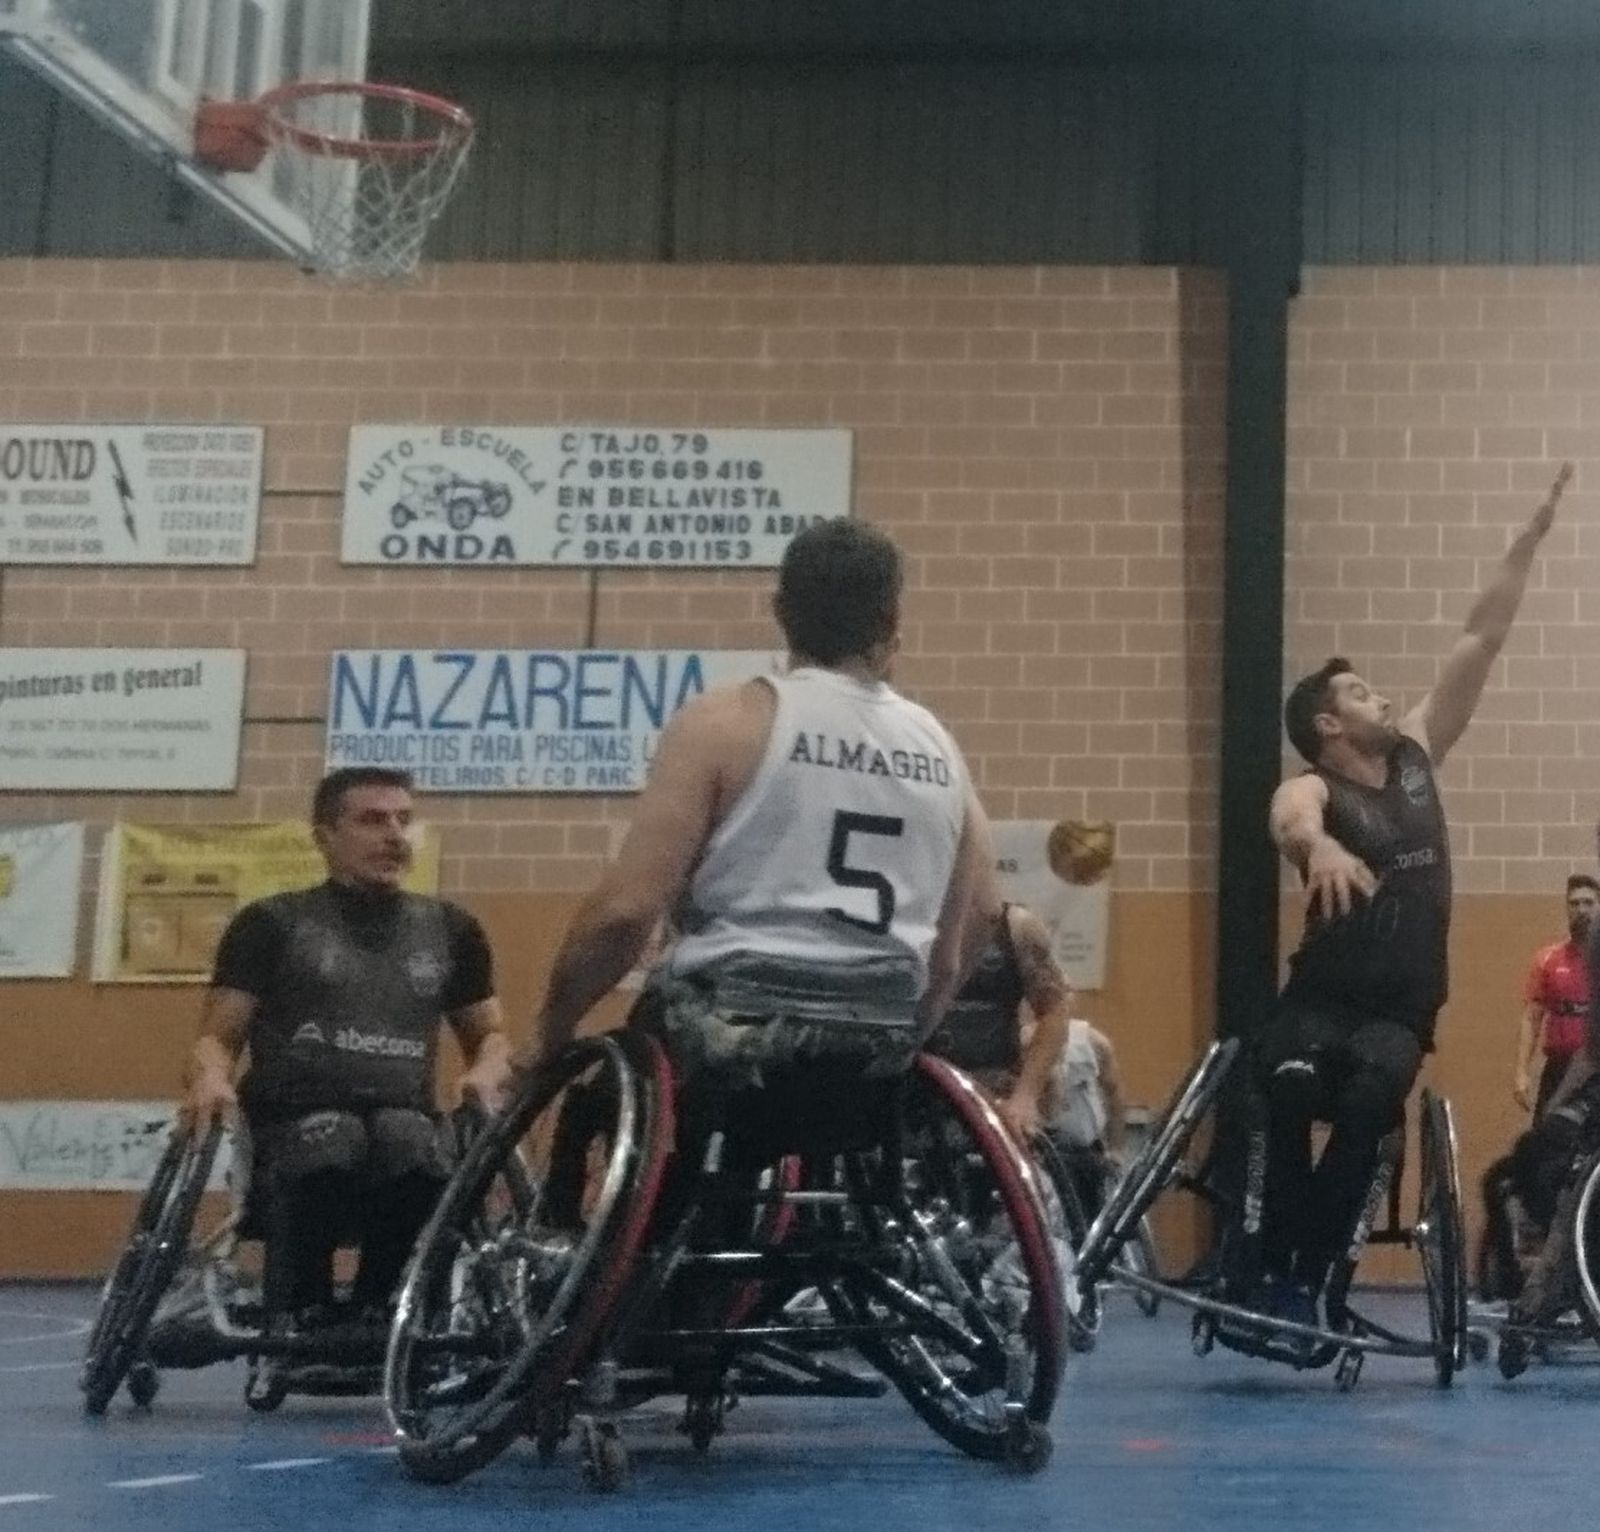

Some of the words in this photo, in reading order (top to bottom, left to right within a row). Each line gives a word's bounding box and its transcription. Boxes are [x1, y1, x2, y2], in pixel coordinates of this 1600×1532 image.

[1, 438, 96, 481] OUND
[672, 433, 708, 454] 79
[358, 441, 414, 495] AUTO
[441, 428, 547, 495] ESCUELA
[557, 486, 594, 507] EN
[607, 486, 781, 508] BELLAVISTA
[584, 514, 632, 534] SAN
[643, 514, 752, 534] ANTONIO
[380, 533, 516, 560] ONDA
[91, 671, 117, 693] en
[123, 660, 203, 697] general
[331, 734, 460, 764] PRODUCTOS
[470, 734, 523, 764] PARA
[535, 734, 632, 763] PISCINAS
[789, 731, 950, 788] ALMAGRO
[826, 808, 904, 935] 5
